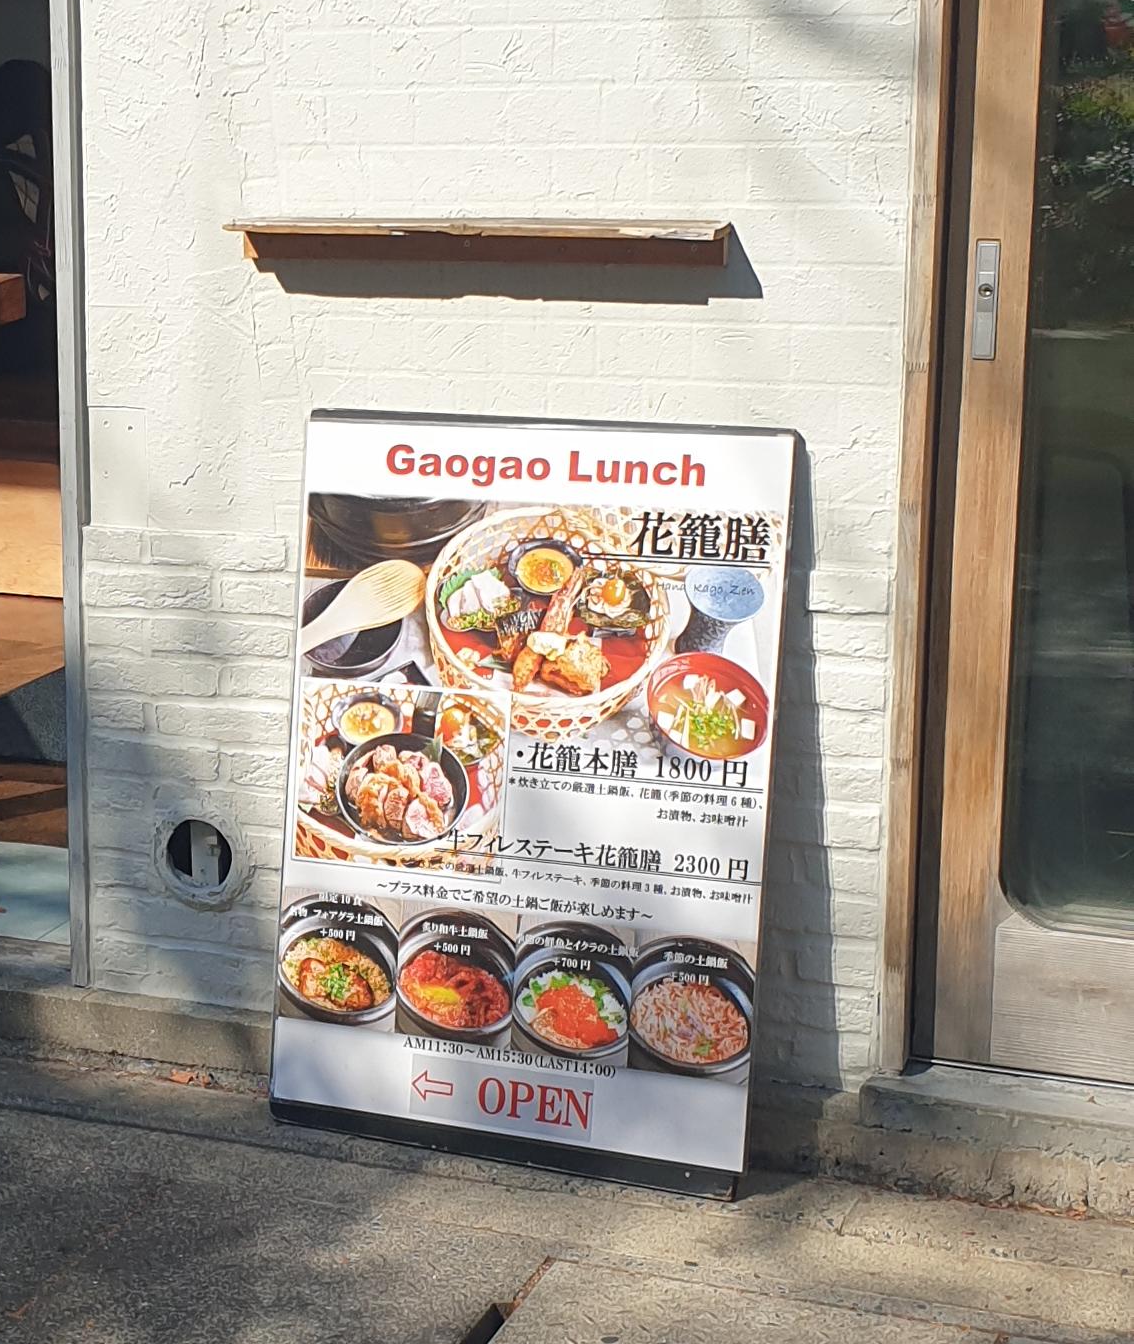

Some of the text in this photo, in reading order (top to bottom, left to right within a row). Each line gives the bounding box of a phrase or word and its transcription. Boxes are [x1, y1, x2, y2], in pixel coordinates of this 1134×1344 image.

[385, 443, 707, 487] Gaogao Lunch
[630, 511, 772, 561] 花籠膳
[477, 1076, 594, 1131] OPEN
